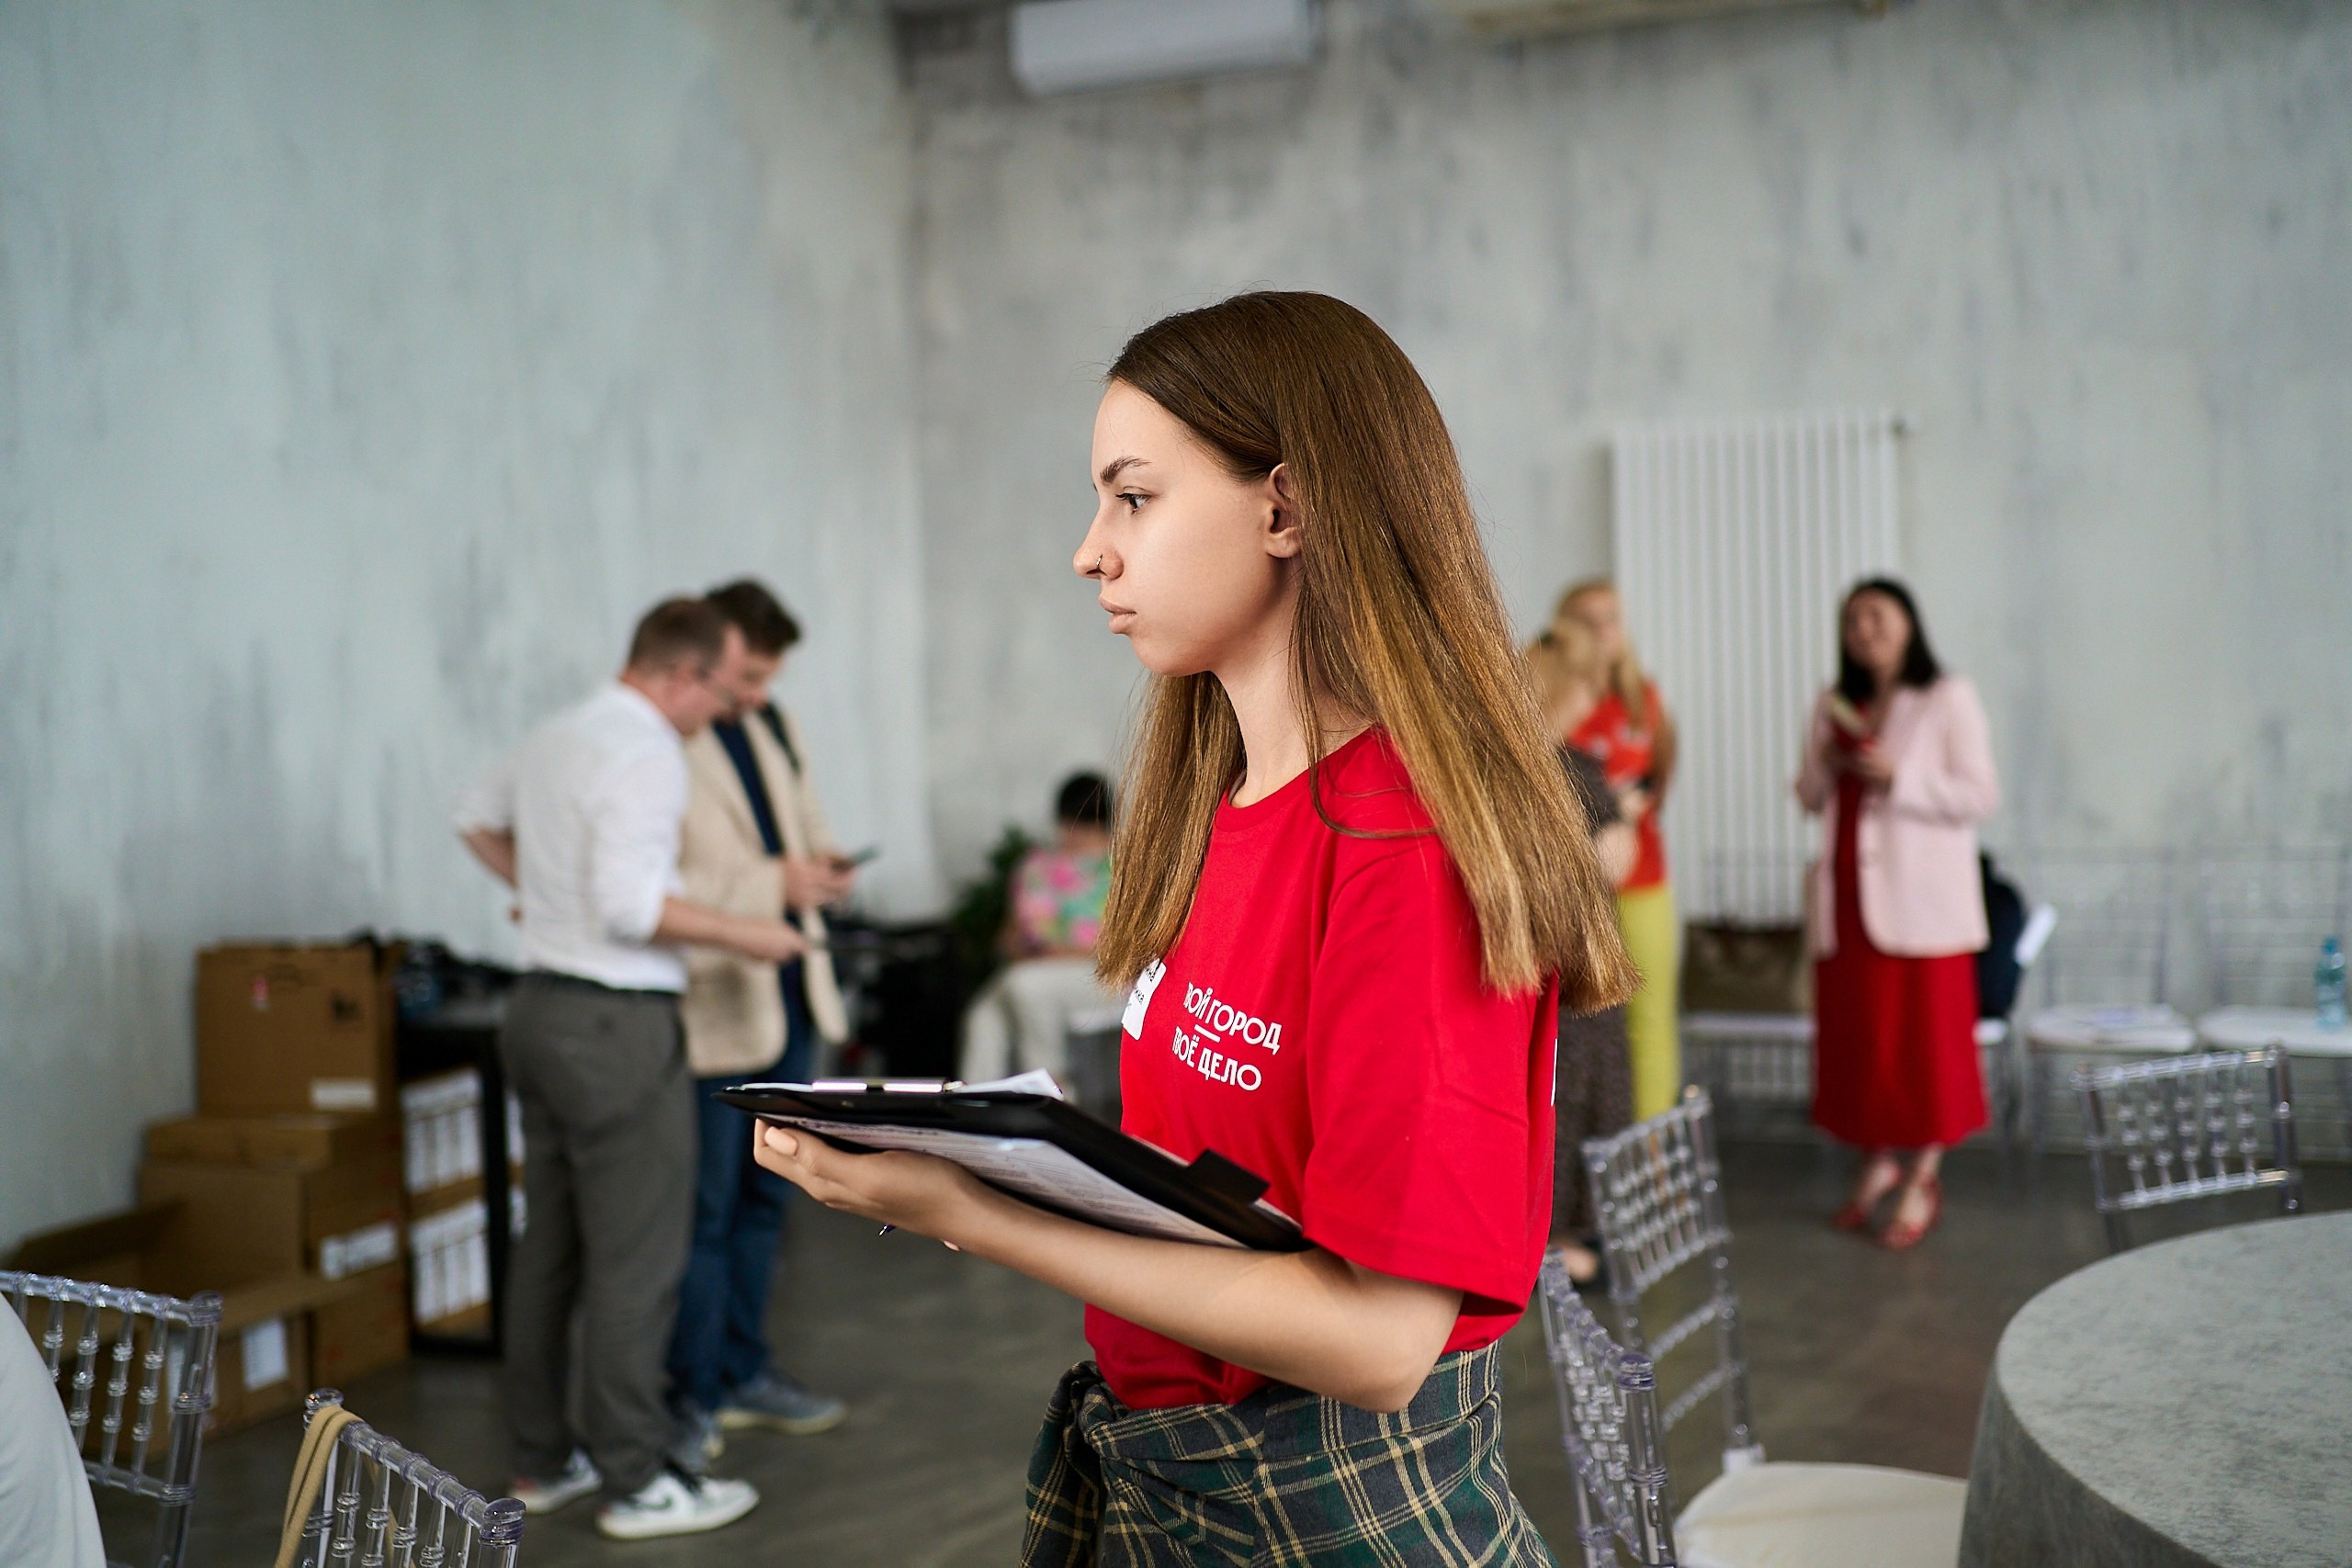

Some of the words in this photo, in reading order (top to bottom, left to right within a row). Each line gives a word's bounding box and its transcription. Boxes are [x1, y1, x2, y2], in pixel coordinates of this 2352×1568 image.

[1205, 999, 1282, 1055] ГОРОД
[1172, 1026, 1200, 1067] ТВОЁ
[1198, 1047, 1261, 1090] ДЕЛО
